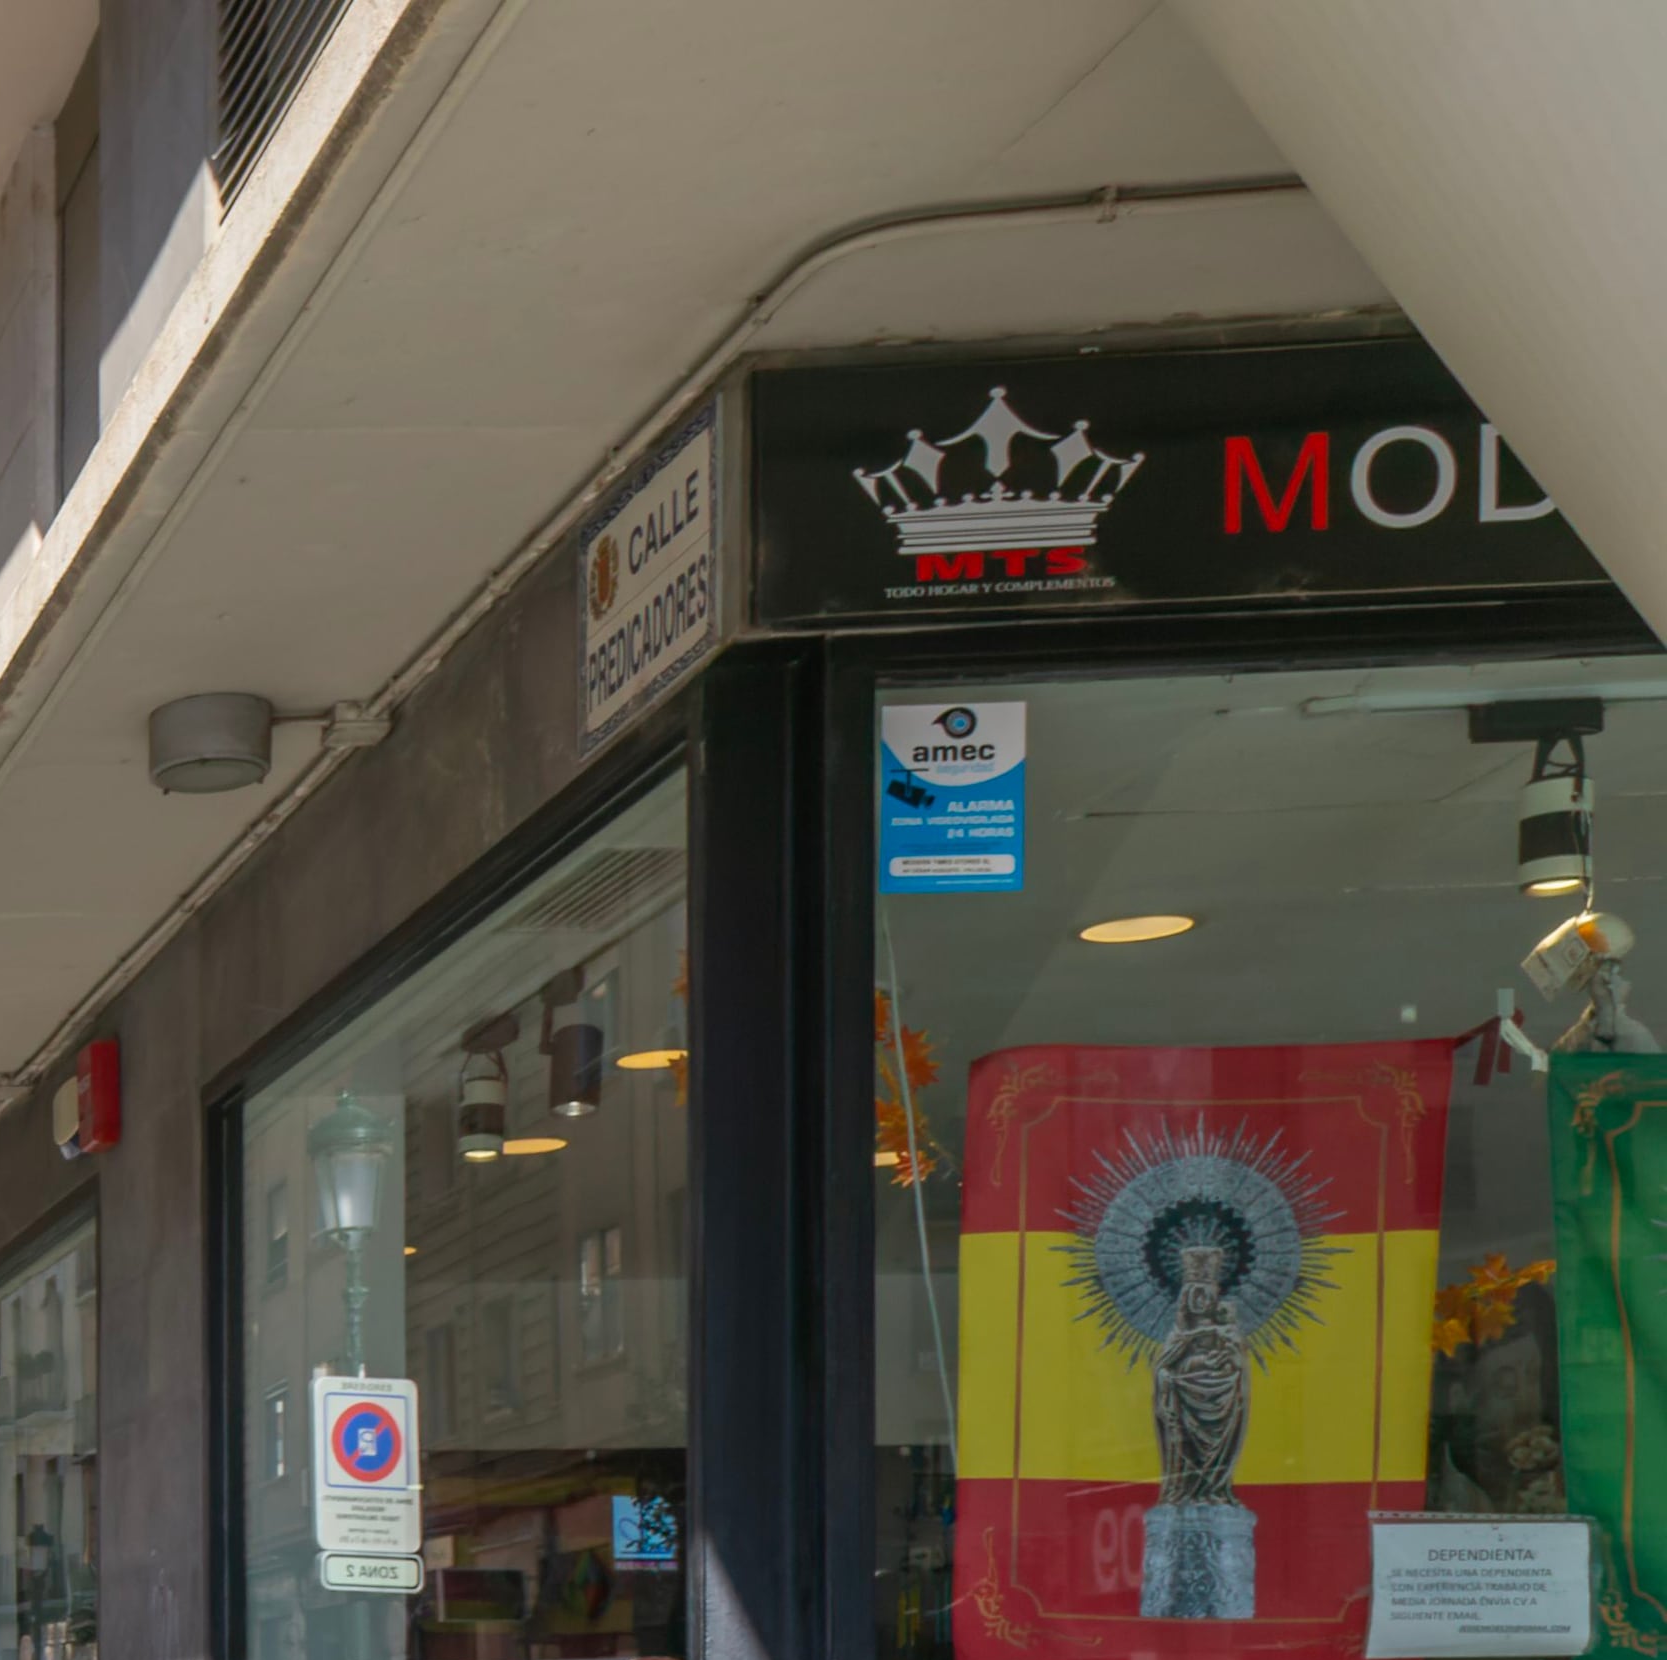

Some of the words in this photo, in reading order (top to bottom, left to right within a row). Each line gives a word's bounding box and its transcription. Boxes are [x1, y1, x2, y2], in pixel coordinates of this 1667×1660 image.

[628, 469, 699, 575] CALLE
[916, 546, 1088, 582] MTS
[884, 586, 924, 599] TODO
[928, 583, 978, 597] HOGAR
[982, 584, 990, 593] Y
[995, 576, 1116, 593] COMPLEMENTOS
[587, 553, 707, 713] PREDICADORES
[912, 743, 995, 763] amec
[1428, 1549, 1535, 1562] DEPENDIENTA
[1481, 1568, 1553, 1577] DEPENDIENTA
